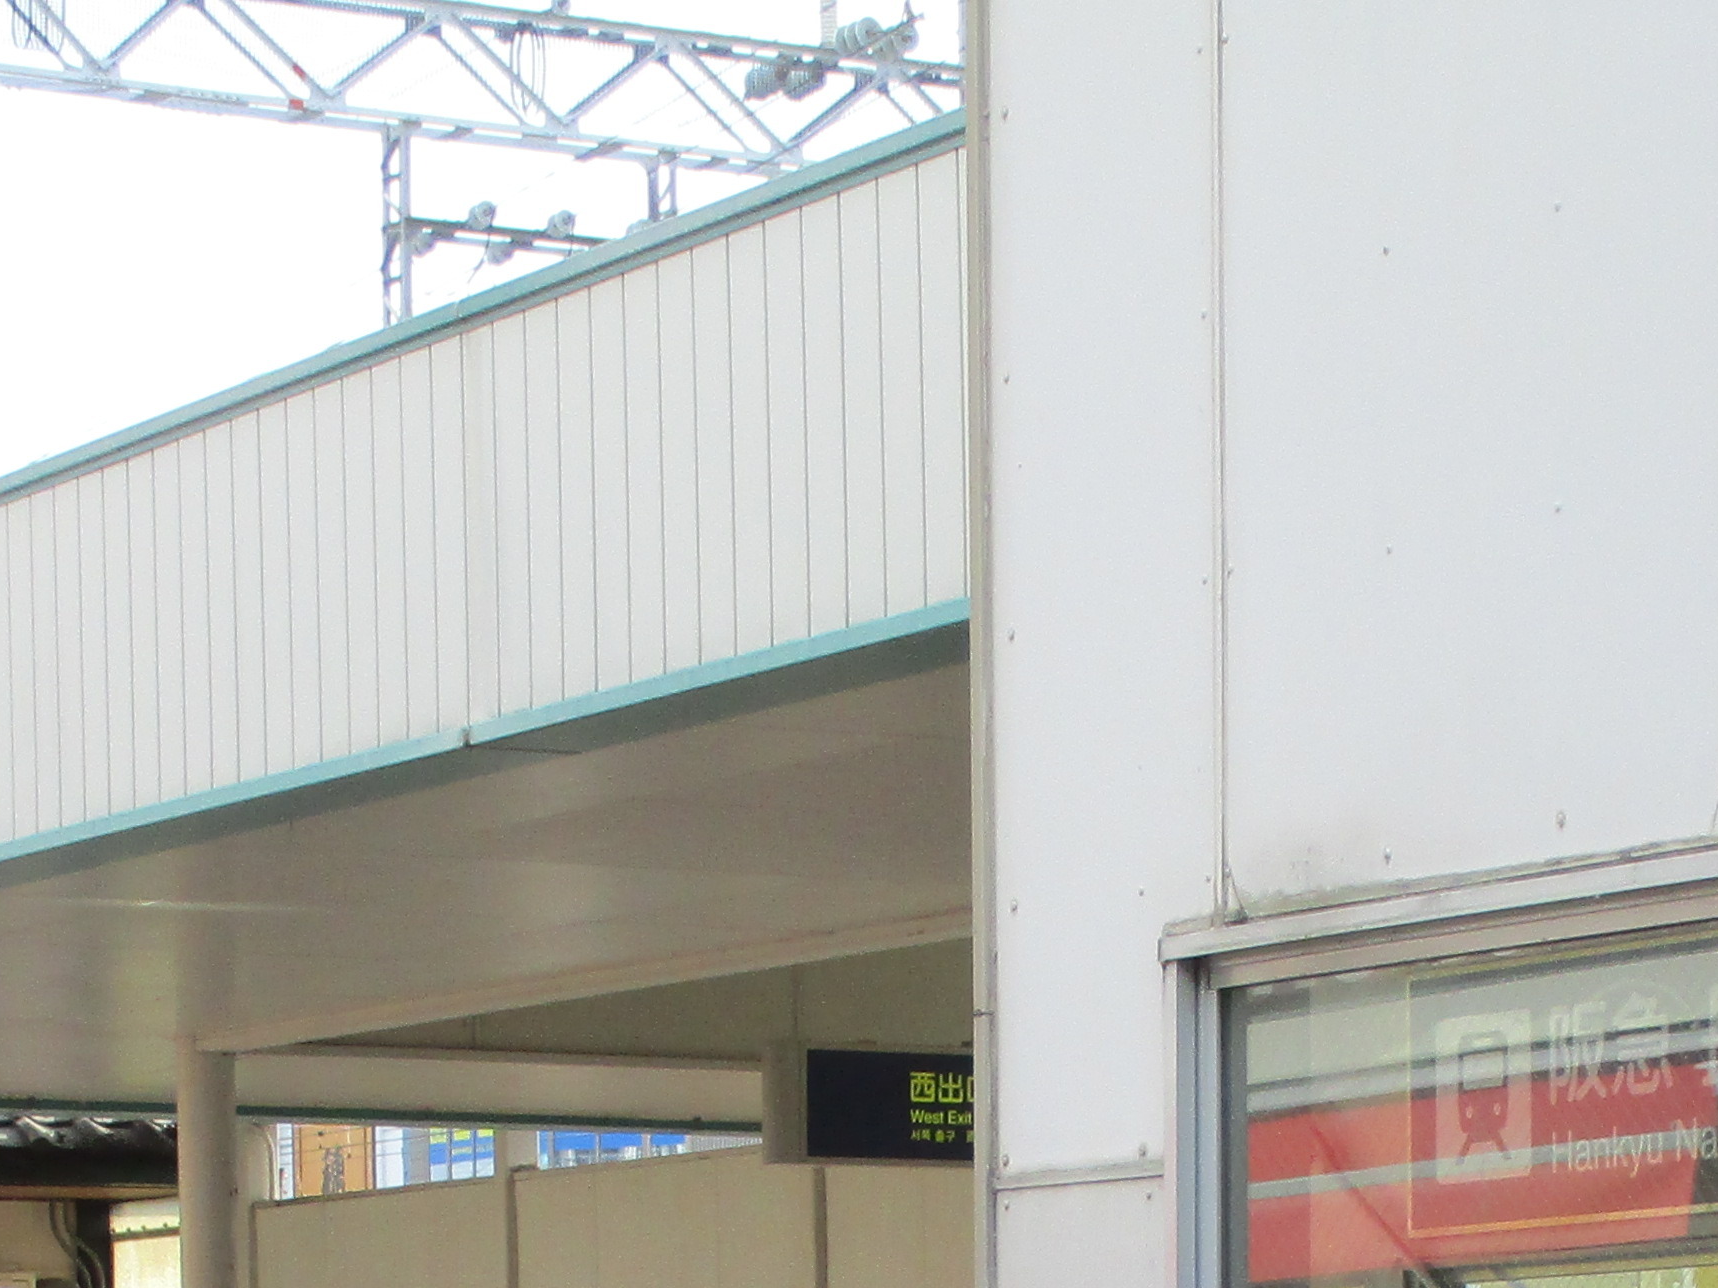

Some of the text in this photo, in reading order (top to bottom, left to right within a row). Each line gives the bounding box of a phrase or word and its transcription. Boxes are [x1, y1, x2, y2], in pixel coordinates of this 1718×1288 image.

[1549, 989, 1674, 1106] 阪急
[910, 1109, 973, 1125] West Exit
[1551, 1125, 1663, 1178] Hankyu
